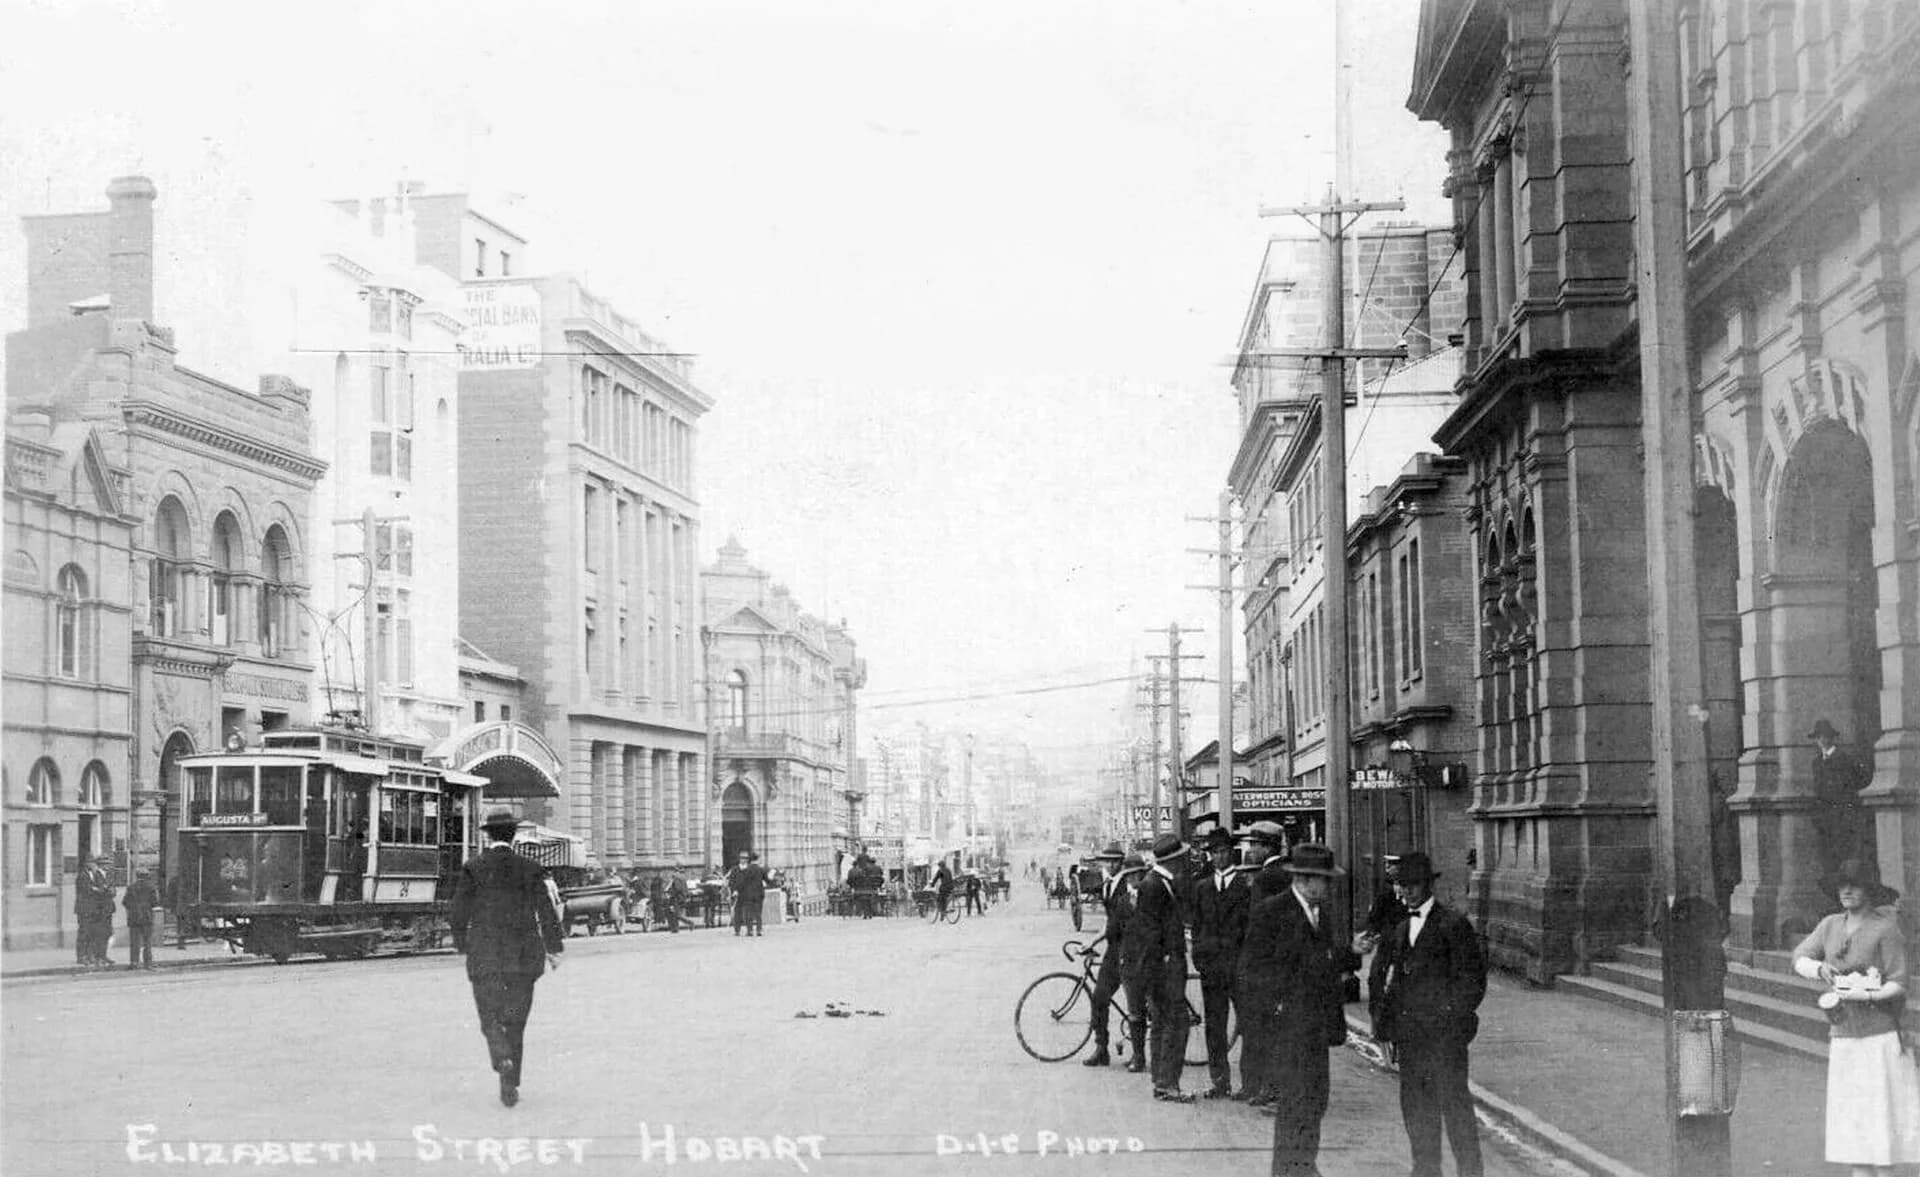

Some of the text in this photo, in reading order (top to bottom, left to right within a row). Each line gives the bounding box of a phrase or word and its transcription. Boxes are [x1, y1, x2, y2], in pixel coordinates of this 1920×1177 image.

[465, 288, 496, 302] THE
[503, 306, 538, 327] BANK
[463, 346, 511, 366] RALIA
[1232, 792, 1289, 801] ATERWORTH
[1242, 799, 1312, 808] OPTICIANS
[201, 815, 250, 825] AUGUSTA
[1134, 807, 1173, 821] KOA
